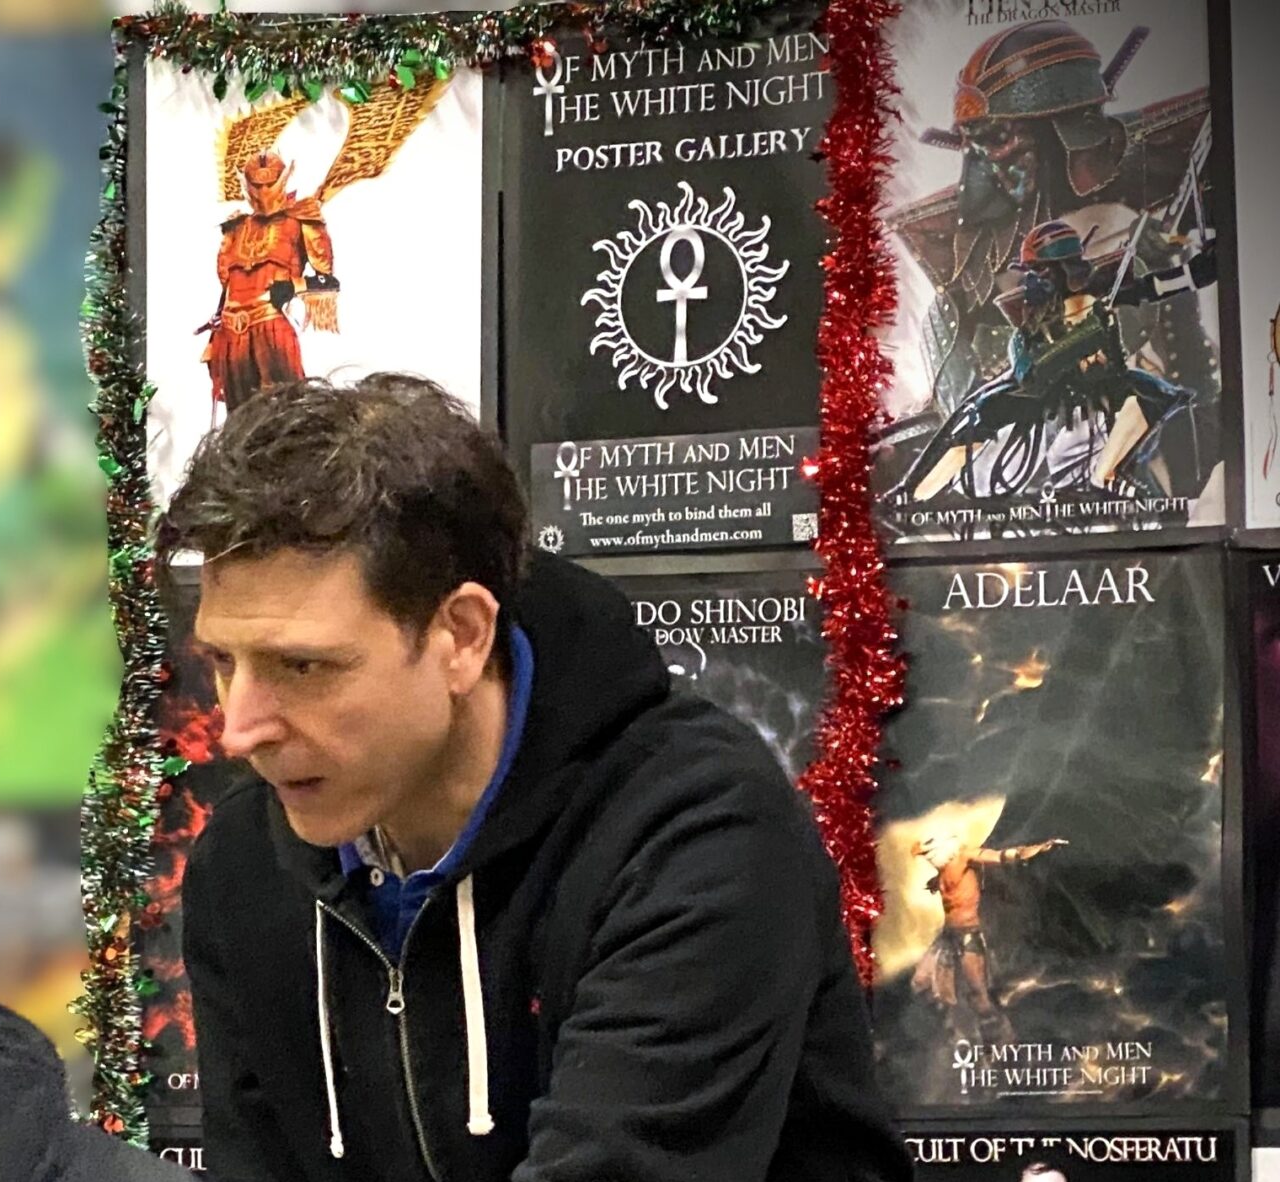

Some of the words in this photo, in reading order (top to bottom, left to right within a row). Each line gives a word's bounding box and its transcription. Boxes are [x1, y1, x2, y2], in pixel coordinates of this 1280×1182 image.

[998, 8, 1059, 22] DRAGON
[1065, 3, 1120, 16] MASTER
[591, 46, 684, 82] MYTH
[698, 48, 755, 72] AND
[767, 32, 830, 66] MEN
[611, 83, 715, 119] WHITE
[727, 71, 830, 109] NIGHT
[555, 141, 664, 172] POSTER
[675, 128, 811, 162] GALLERY
[600, 442, 673, 468] MYTH
[683, 444, 729, 464] AND
[739, 435, 795, 460] MEN
[616, 472, 699, 497] WHITE
[707, 467, 794, 493] NIGHT
[580, 513, 602, 526] The
[605, 513, 629, 525] one
[632, 508, 665, 526] myth
[669, 509, 682, 522] to
[685, 506, 715, 521] bind
[718, 504, 752, 519] them
[754, 503, 771, 517] all
[912, 512, 933, 526] OF
[936, 510, 981, 525] MYTH
[987, 513, 1005, 522] AND
[1010, 506, 1041, 522] MEN
[1079, 501, 1129, 516] WHITE
[1134, 497, 1188, 514] NIGHT
[590, 529, 762, 548] www.ofmythandmen.com
[943, 565, 1156, 610] ADELAAR
[631, 601, 681, 625] DO
[691, 597, 806, 624] SHINOBI
[711, 626, 783, 644] MASTER
[991, 1043, 1053, 1063] MYTH
[1060, 1046, 1099, 1062] AND
[1106, 1042, 1152, 1060] MEN
[1004, 1067, 1072, 1087] WHITE
[1079, 1066, 1152, 1086] NIGHT
[970, 1137, 1006, 1162] OF
[1068, 1136, 1217, 1163] NOSFERATU
